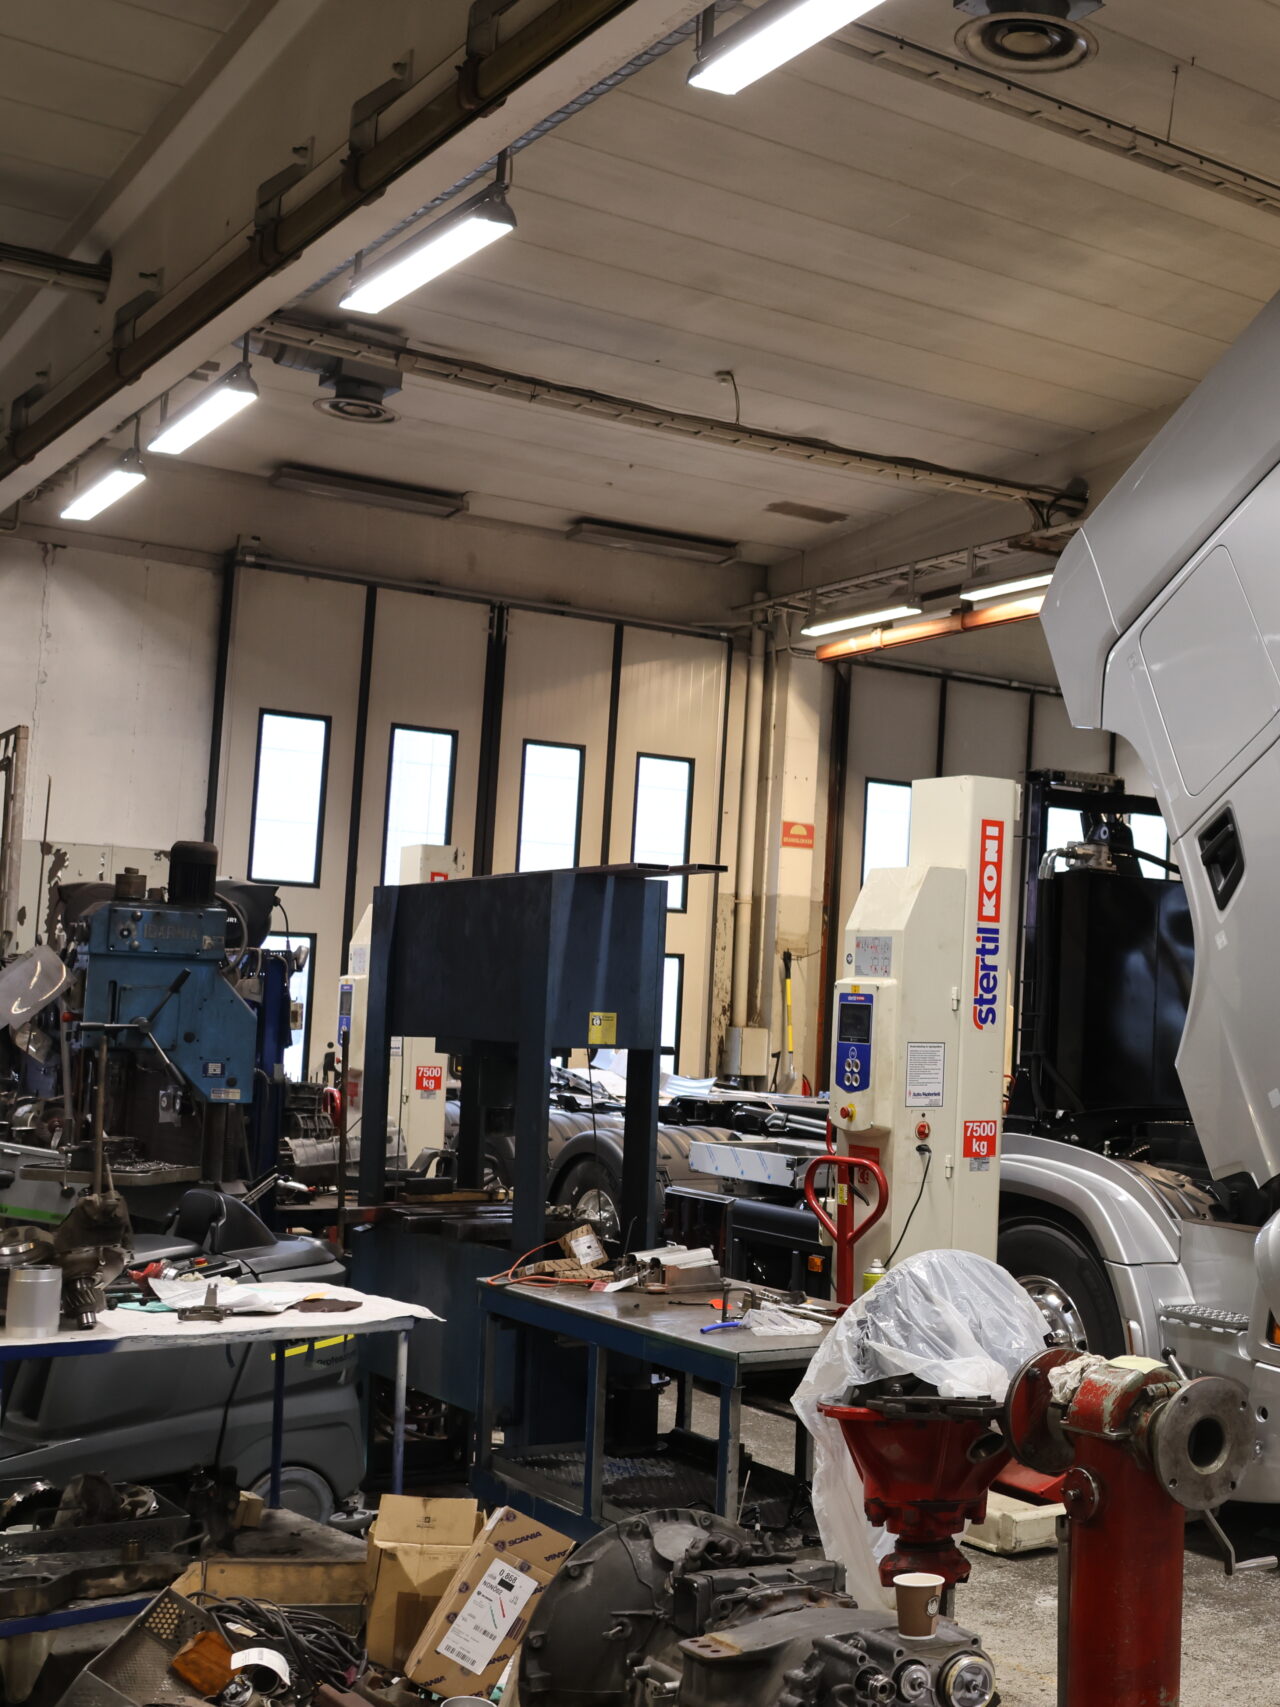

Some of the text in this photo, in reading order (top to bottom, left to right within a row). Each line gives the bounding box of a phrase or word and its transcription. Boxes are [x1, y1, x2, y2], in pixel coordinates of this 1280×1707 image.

[973, 825, 1000, 1031] stertil KONI
[418, 1067, 441, 1077] 7500
[422, 1077, 435, 1089] kg
[965, 1122, 995, 1137] 7500
[972, 1138, 988, 1156] kg
[508, 1531, 543, 1547] SCANIA
